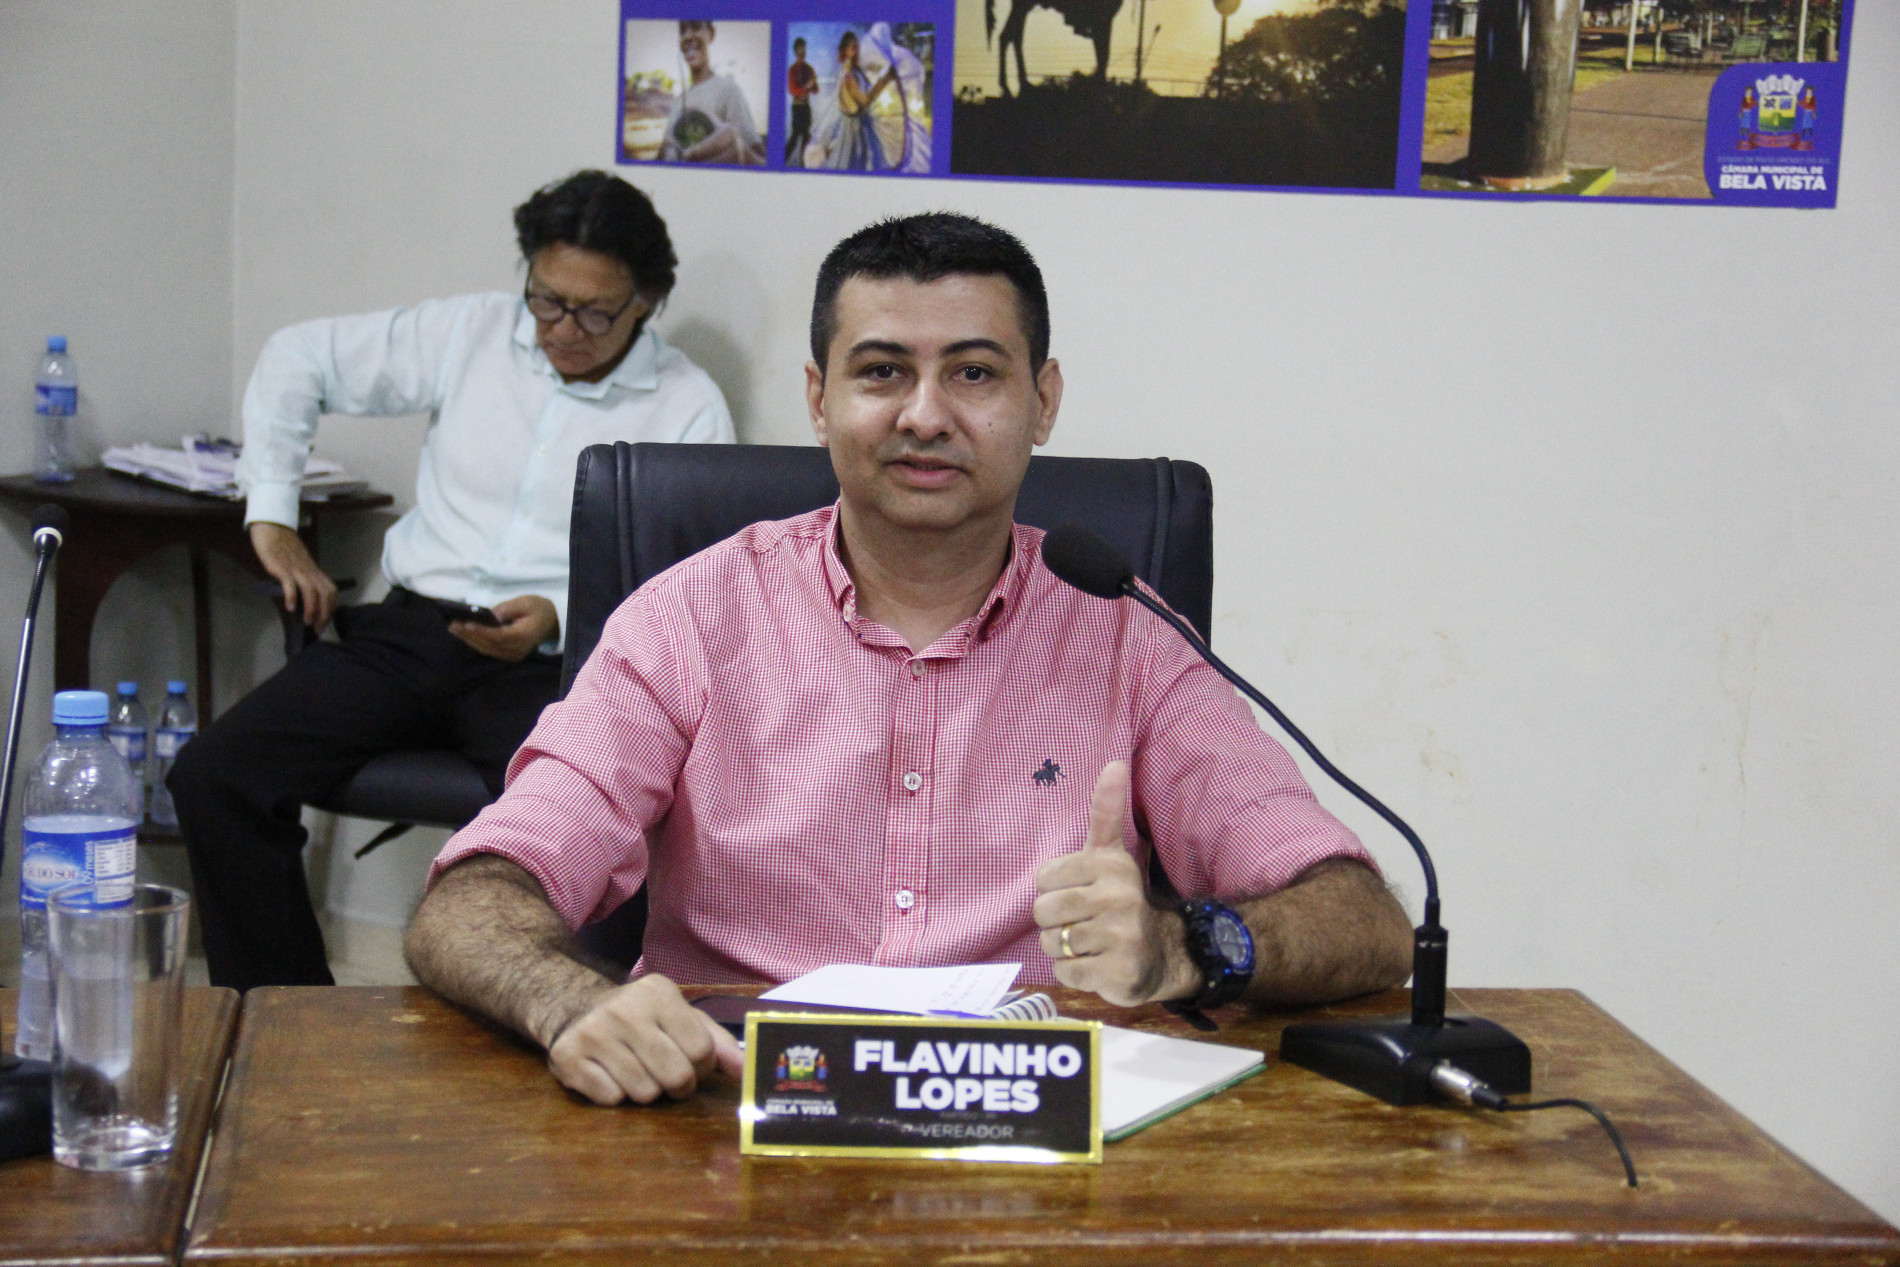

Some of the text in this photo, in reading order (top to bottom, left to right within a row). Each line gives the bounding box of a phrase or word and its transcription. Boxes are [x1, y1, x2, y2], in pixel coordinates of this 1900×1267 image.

[1720, 174, 1827, 191] BELA VISTA
[854, 1039, 1082, 1078] FLAVINHO
[895, 1076, 1040, 1113] LOPES
[800, 1104, 838, 1116] VISTA
[920, 1123, 1015, 1139] VEREADOR
